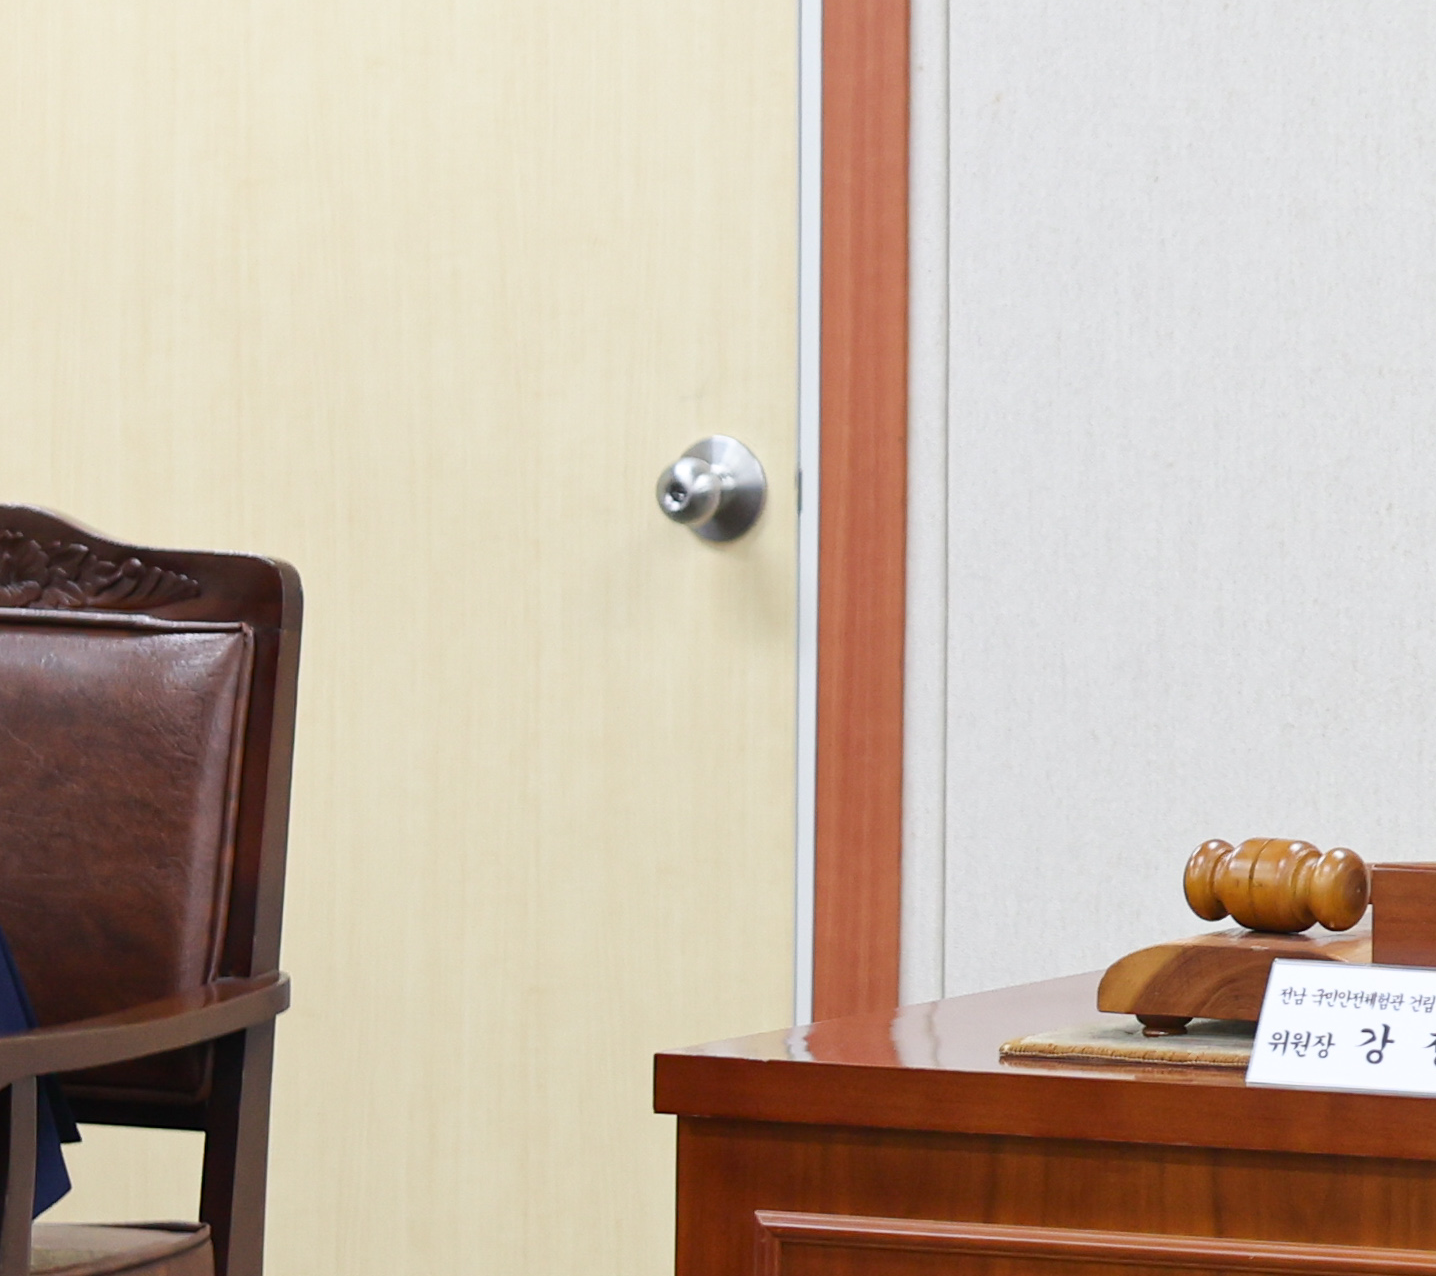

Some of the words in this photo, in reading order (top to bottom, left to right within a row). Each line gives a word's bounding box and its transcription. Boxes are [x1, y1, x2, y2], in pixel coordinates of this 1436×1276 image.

[1281, 986, 1307, 1006] 전남
[1311, 988, 1405, 1012] 국민안전체험관
[1409, 994, 1436, 1014] 건립
[1268, 1029, 1336, 1060] 위원장
